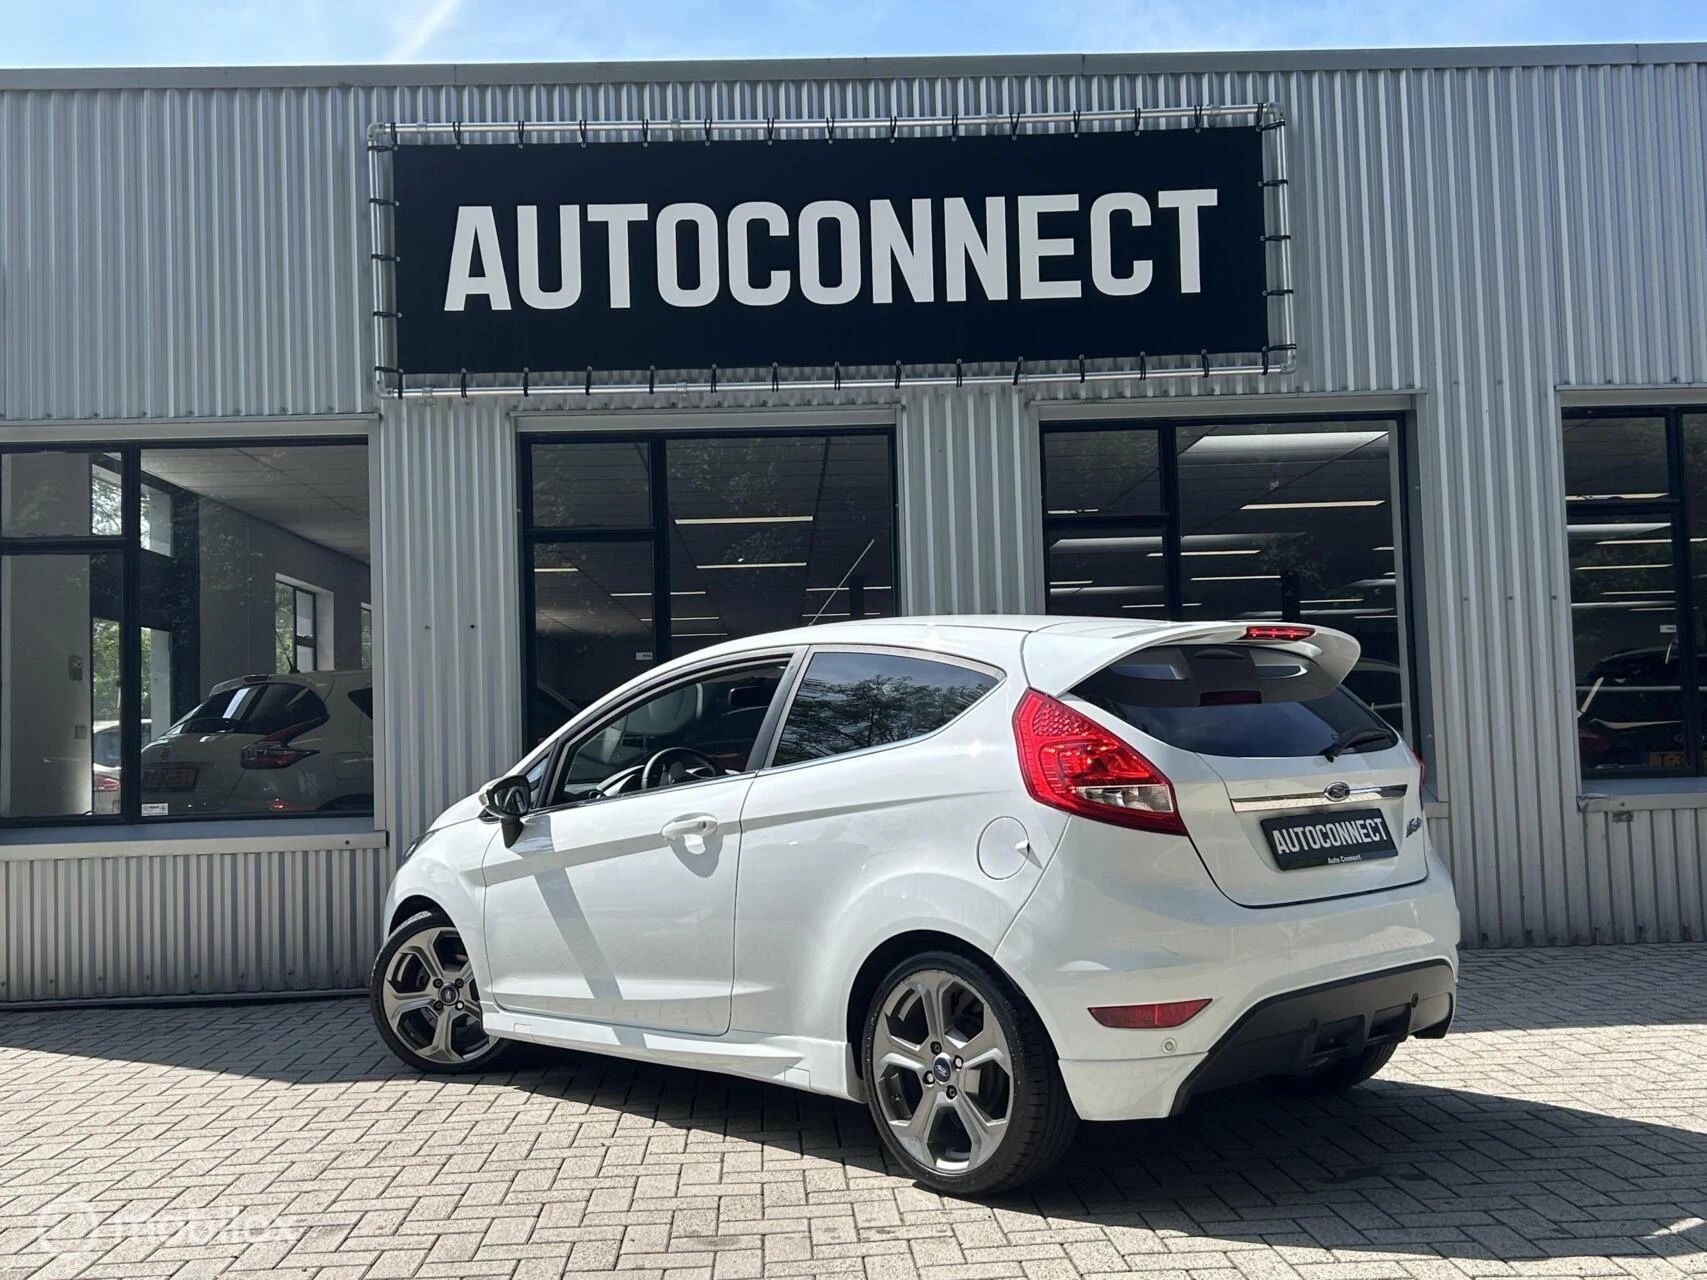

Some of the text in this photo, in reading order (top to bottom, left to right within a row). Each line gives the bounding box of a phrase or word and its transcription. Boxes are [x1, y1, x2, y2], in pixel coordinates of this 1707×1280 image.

[444, 188, 1218, 312] AUTOCONNECT
[1272, 817, 1388, 855] AUTOCONNECT
[1327, 854, 1362, 865] Auto Connect
